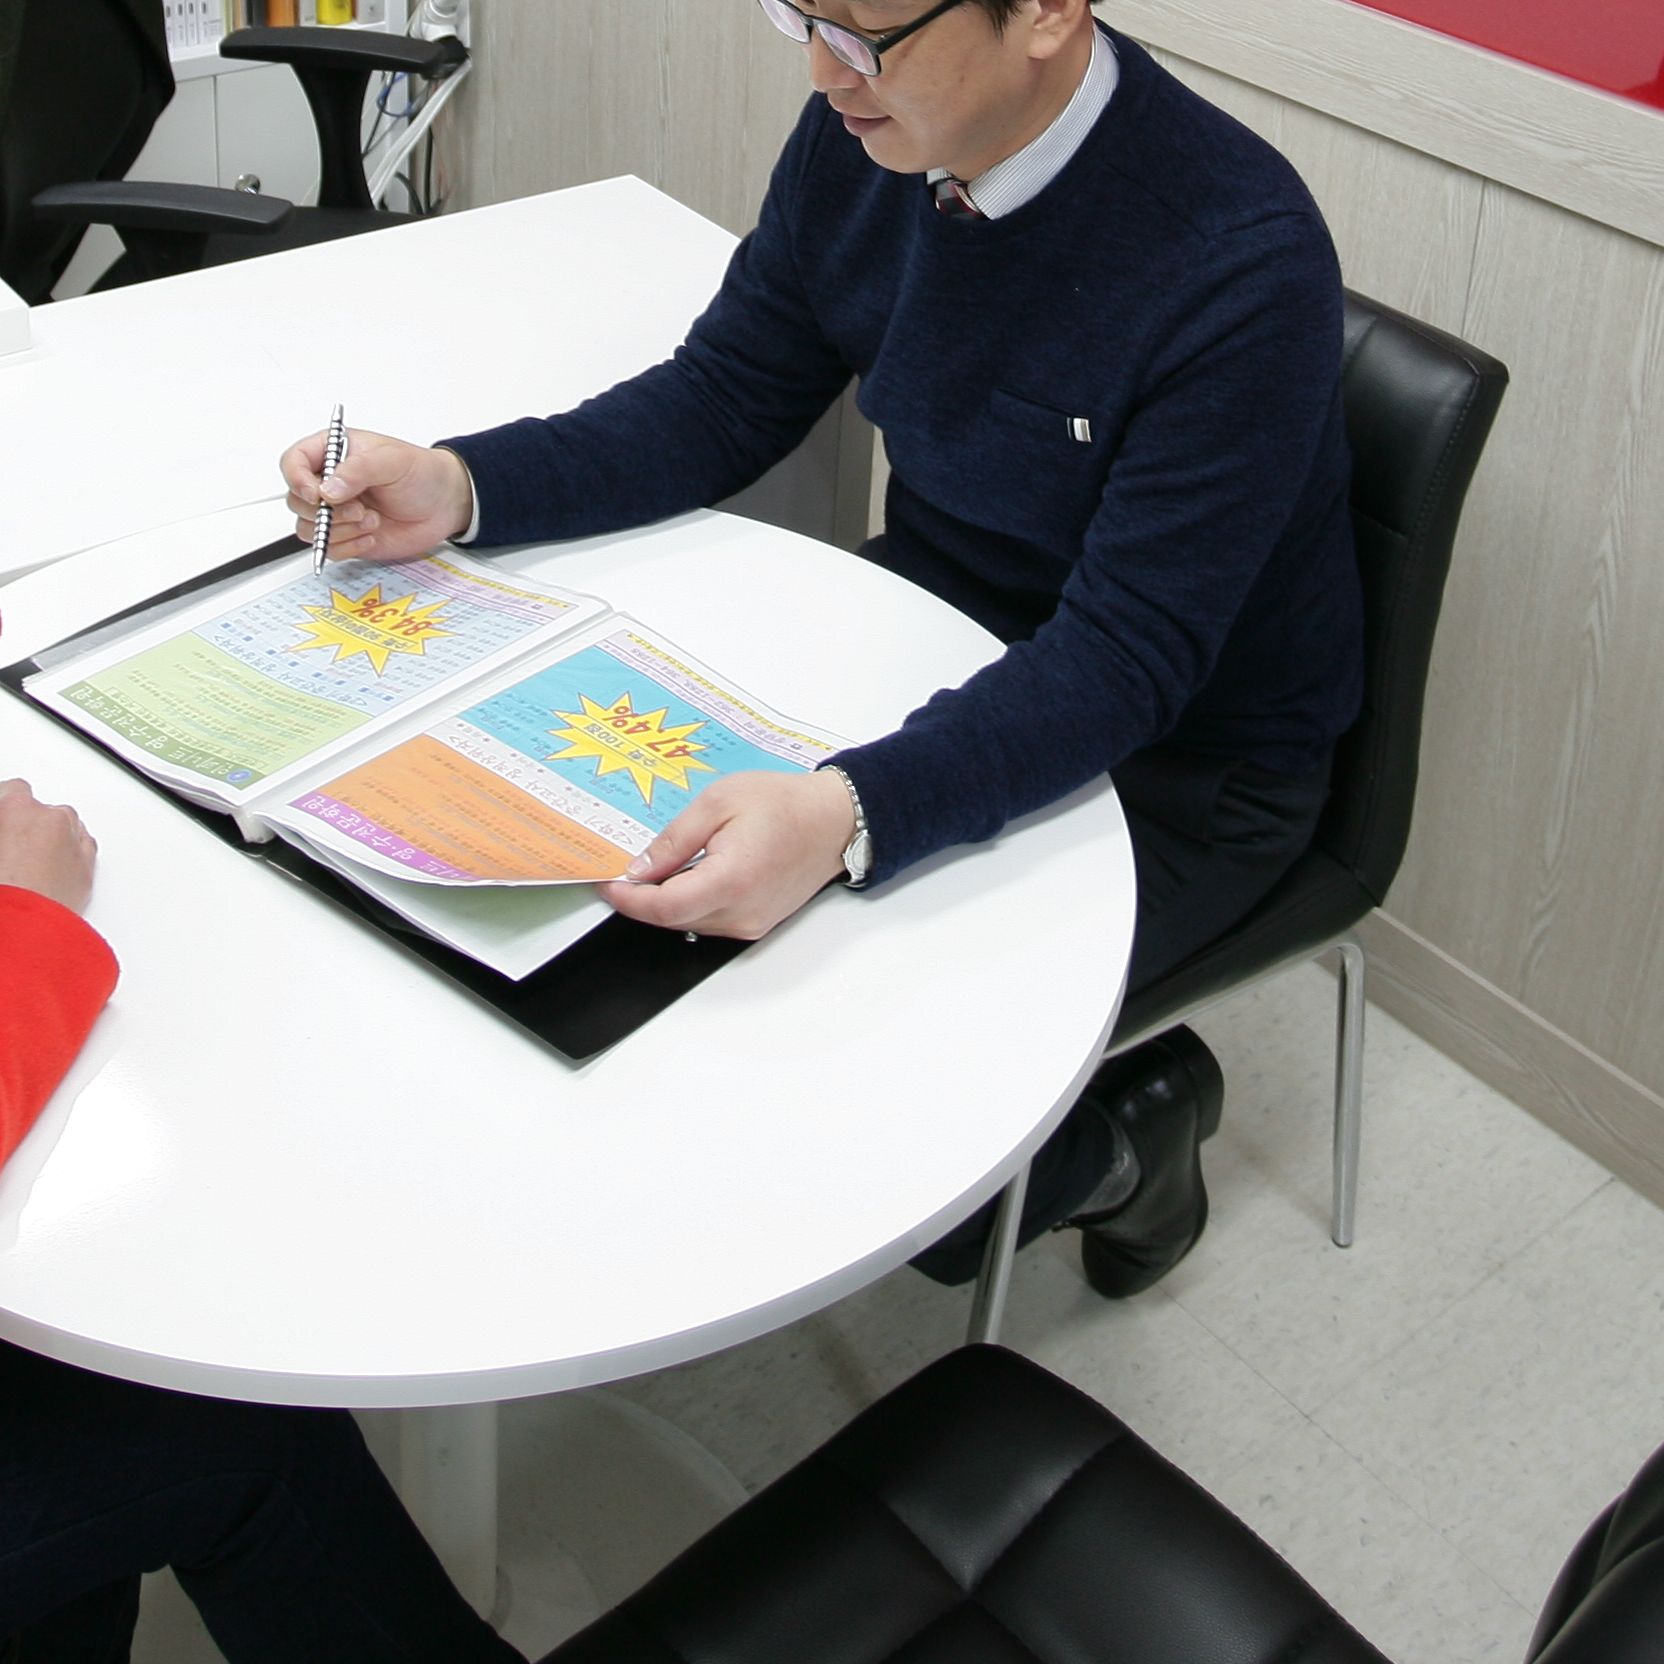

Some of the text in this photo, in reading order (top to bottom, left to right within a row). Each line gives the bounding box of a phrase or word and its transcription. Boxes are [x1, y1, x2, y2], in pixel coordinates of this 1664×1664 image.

[350, 597, 434, 636] 84.3%
[602, 705, 691, 758] 47.4%
[300, 794, 412, 861] 영·수전문학원
